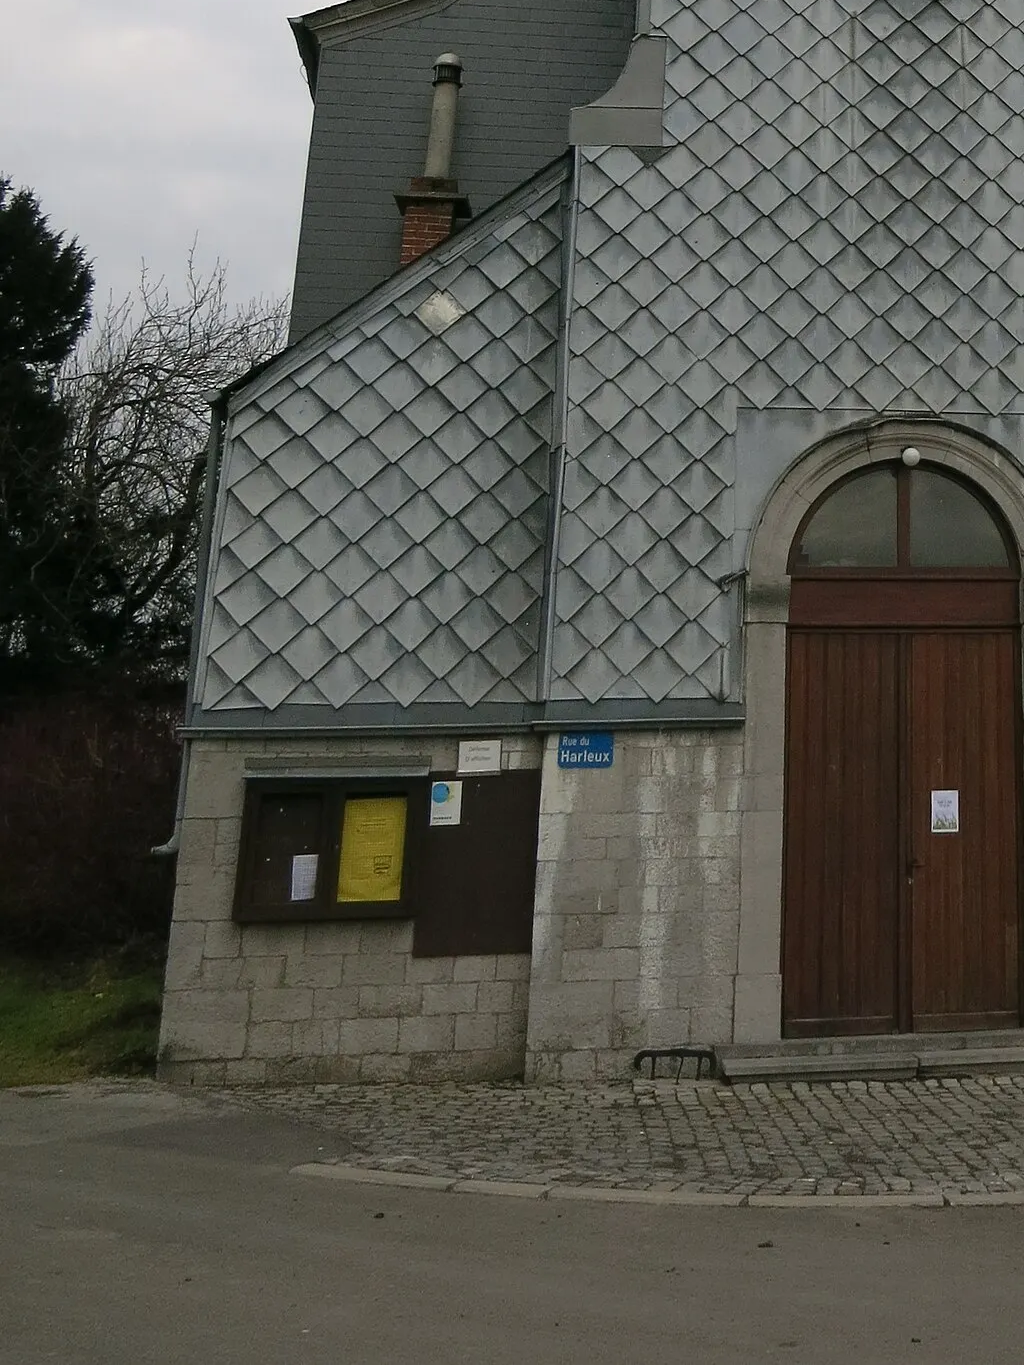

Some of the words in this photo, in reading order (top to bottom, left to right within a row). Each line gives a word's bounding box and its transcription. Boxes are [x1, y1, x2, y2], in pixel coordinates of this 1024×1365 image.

[562, 736, 577, 746] Rue
[580, 736, 590, 746] du
[561, 750, 610, 763] Harleux
